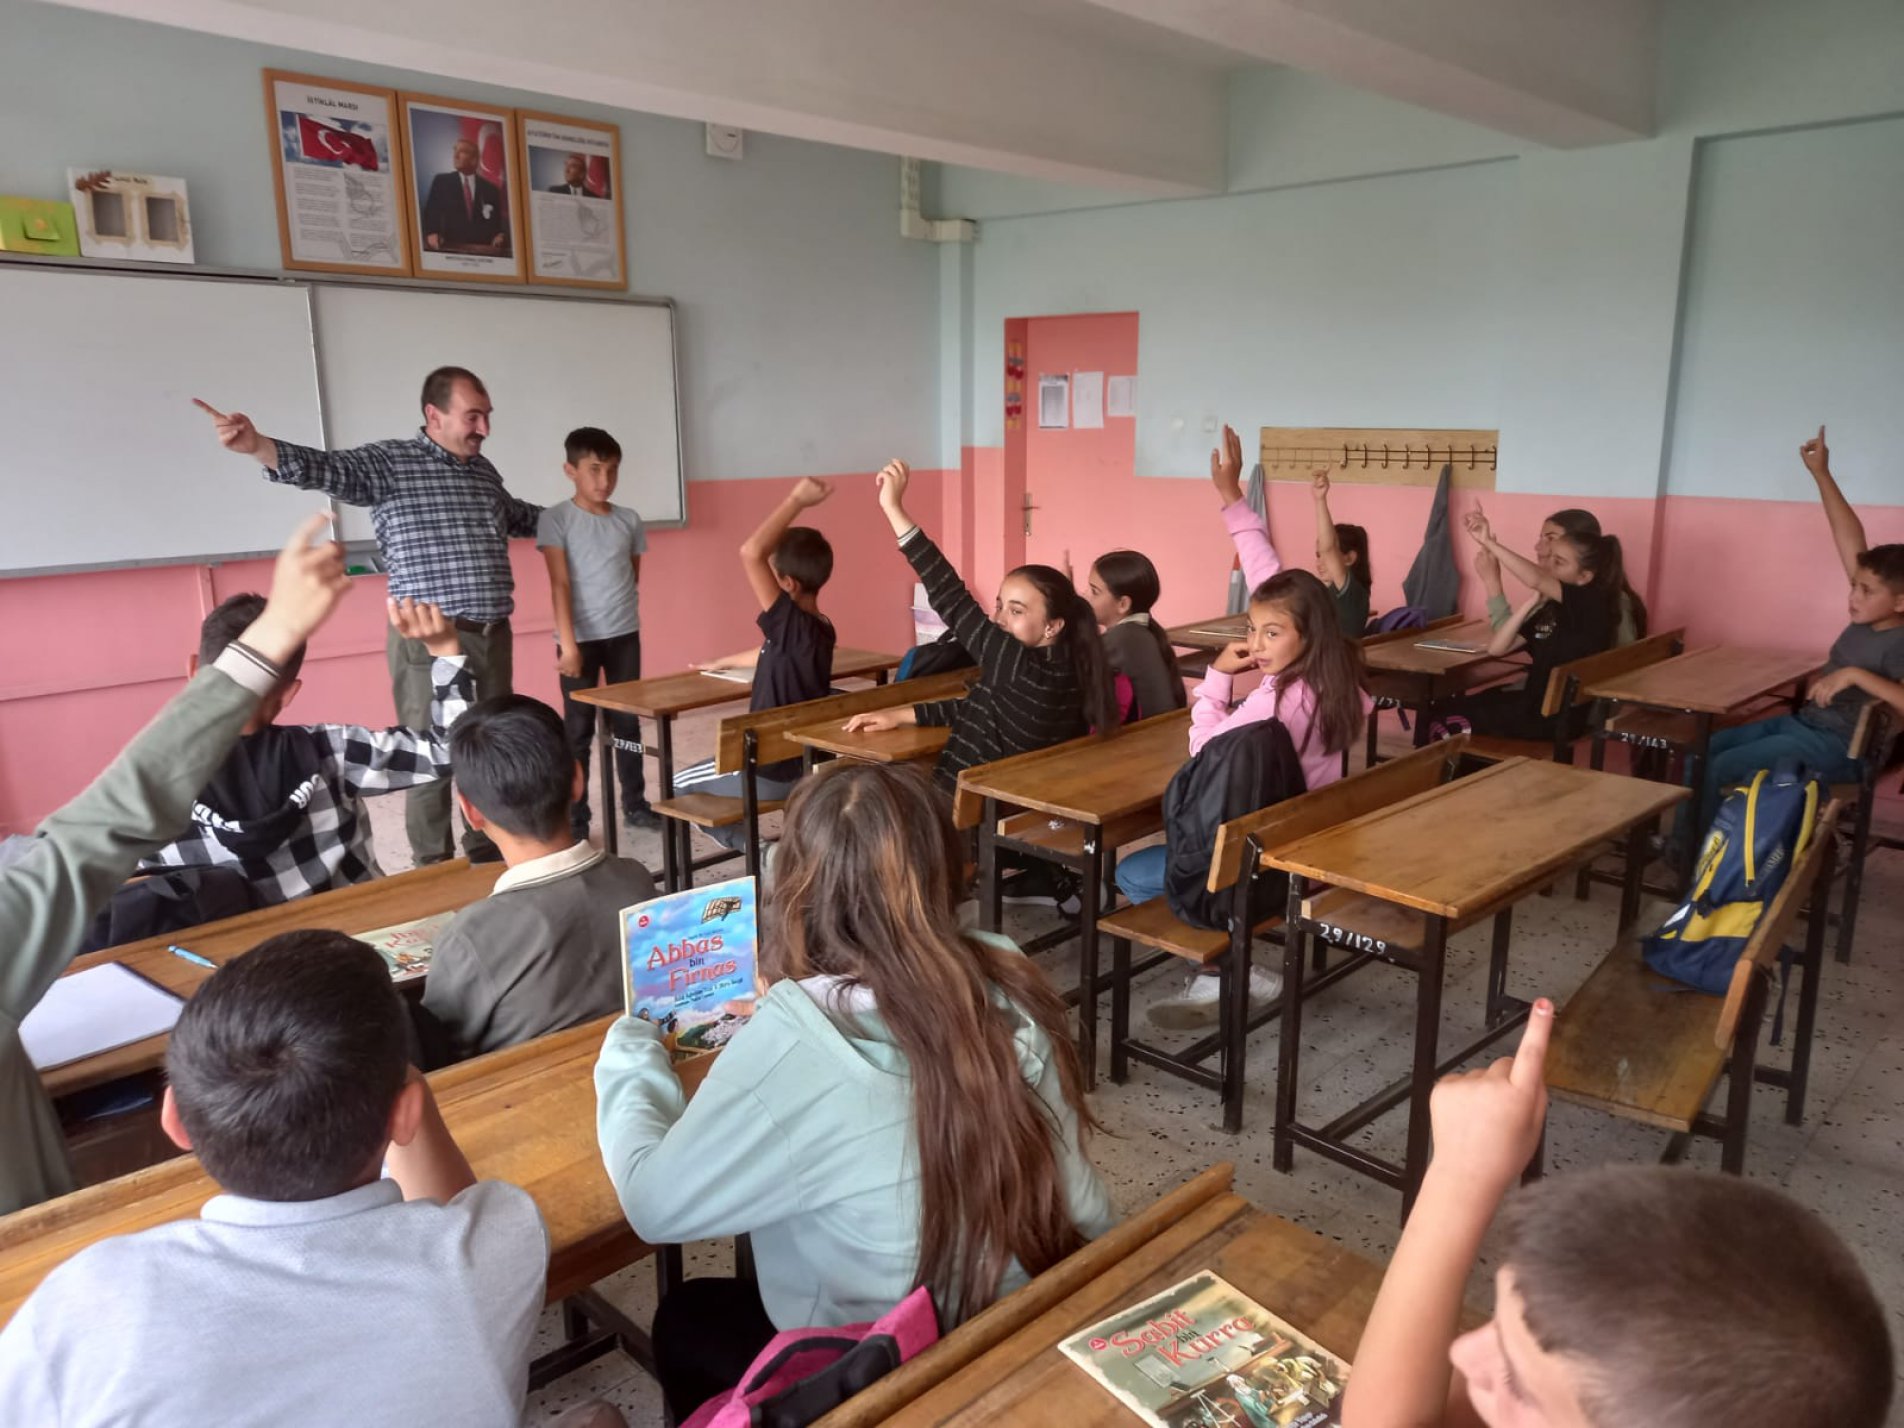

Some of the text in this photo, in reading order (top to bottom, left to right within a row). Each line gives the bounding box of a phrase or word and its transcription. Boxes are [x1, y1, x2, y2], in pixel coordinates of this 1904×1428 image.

[646, 934, 724, 972] Abbas
[1320, 922, 1386, 955] 29/129
[669, 959, 737, 992] Firnas
[689, 957, 705, 968] bin
[1110, 1308, 1197, 1358] Sabit
[1157, 1316, 1255, 1368] Kurra
[1176, 1329, 1200, 1344] bin
